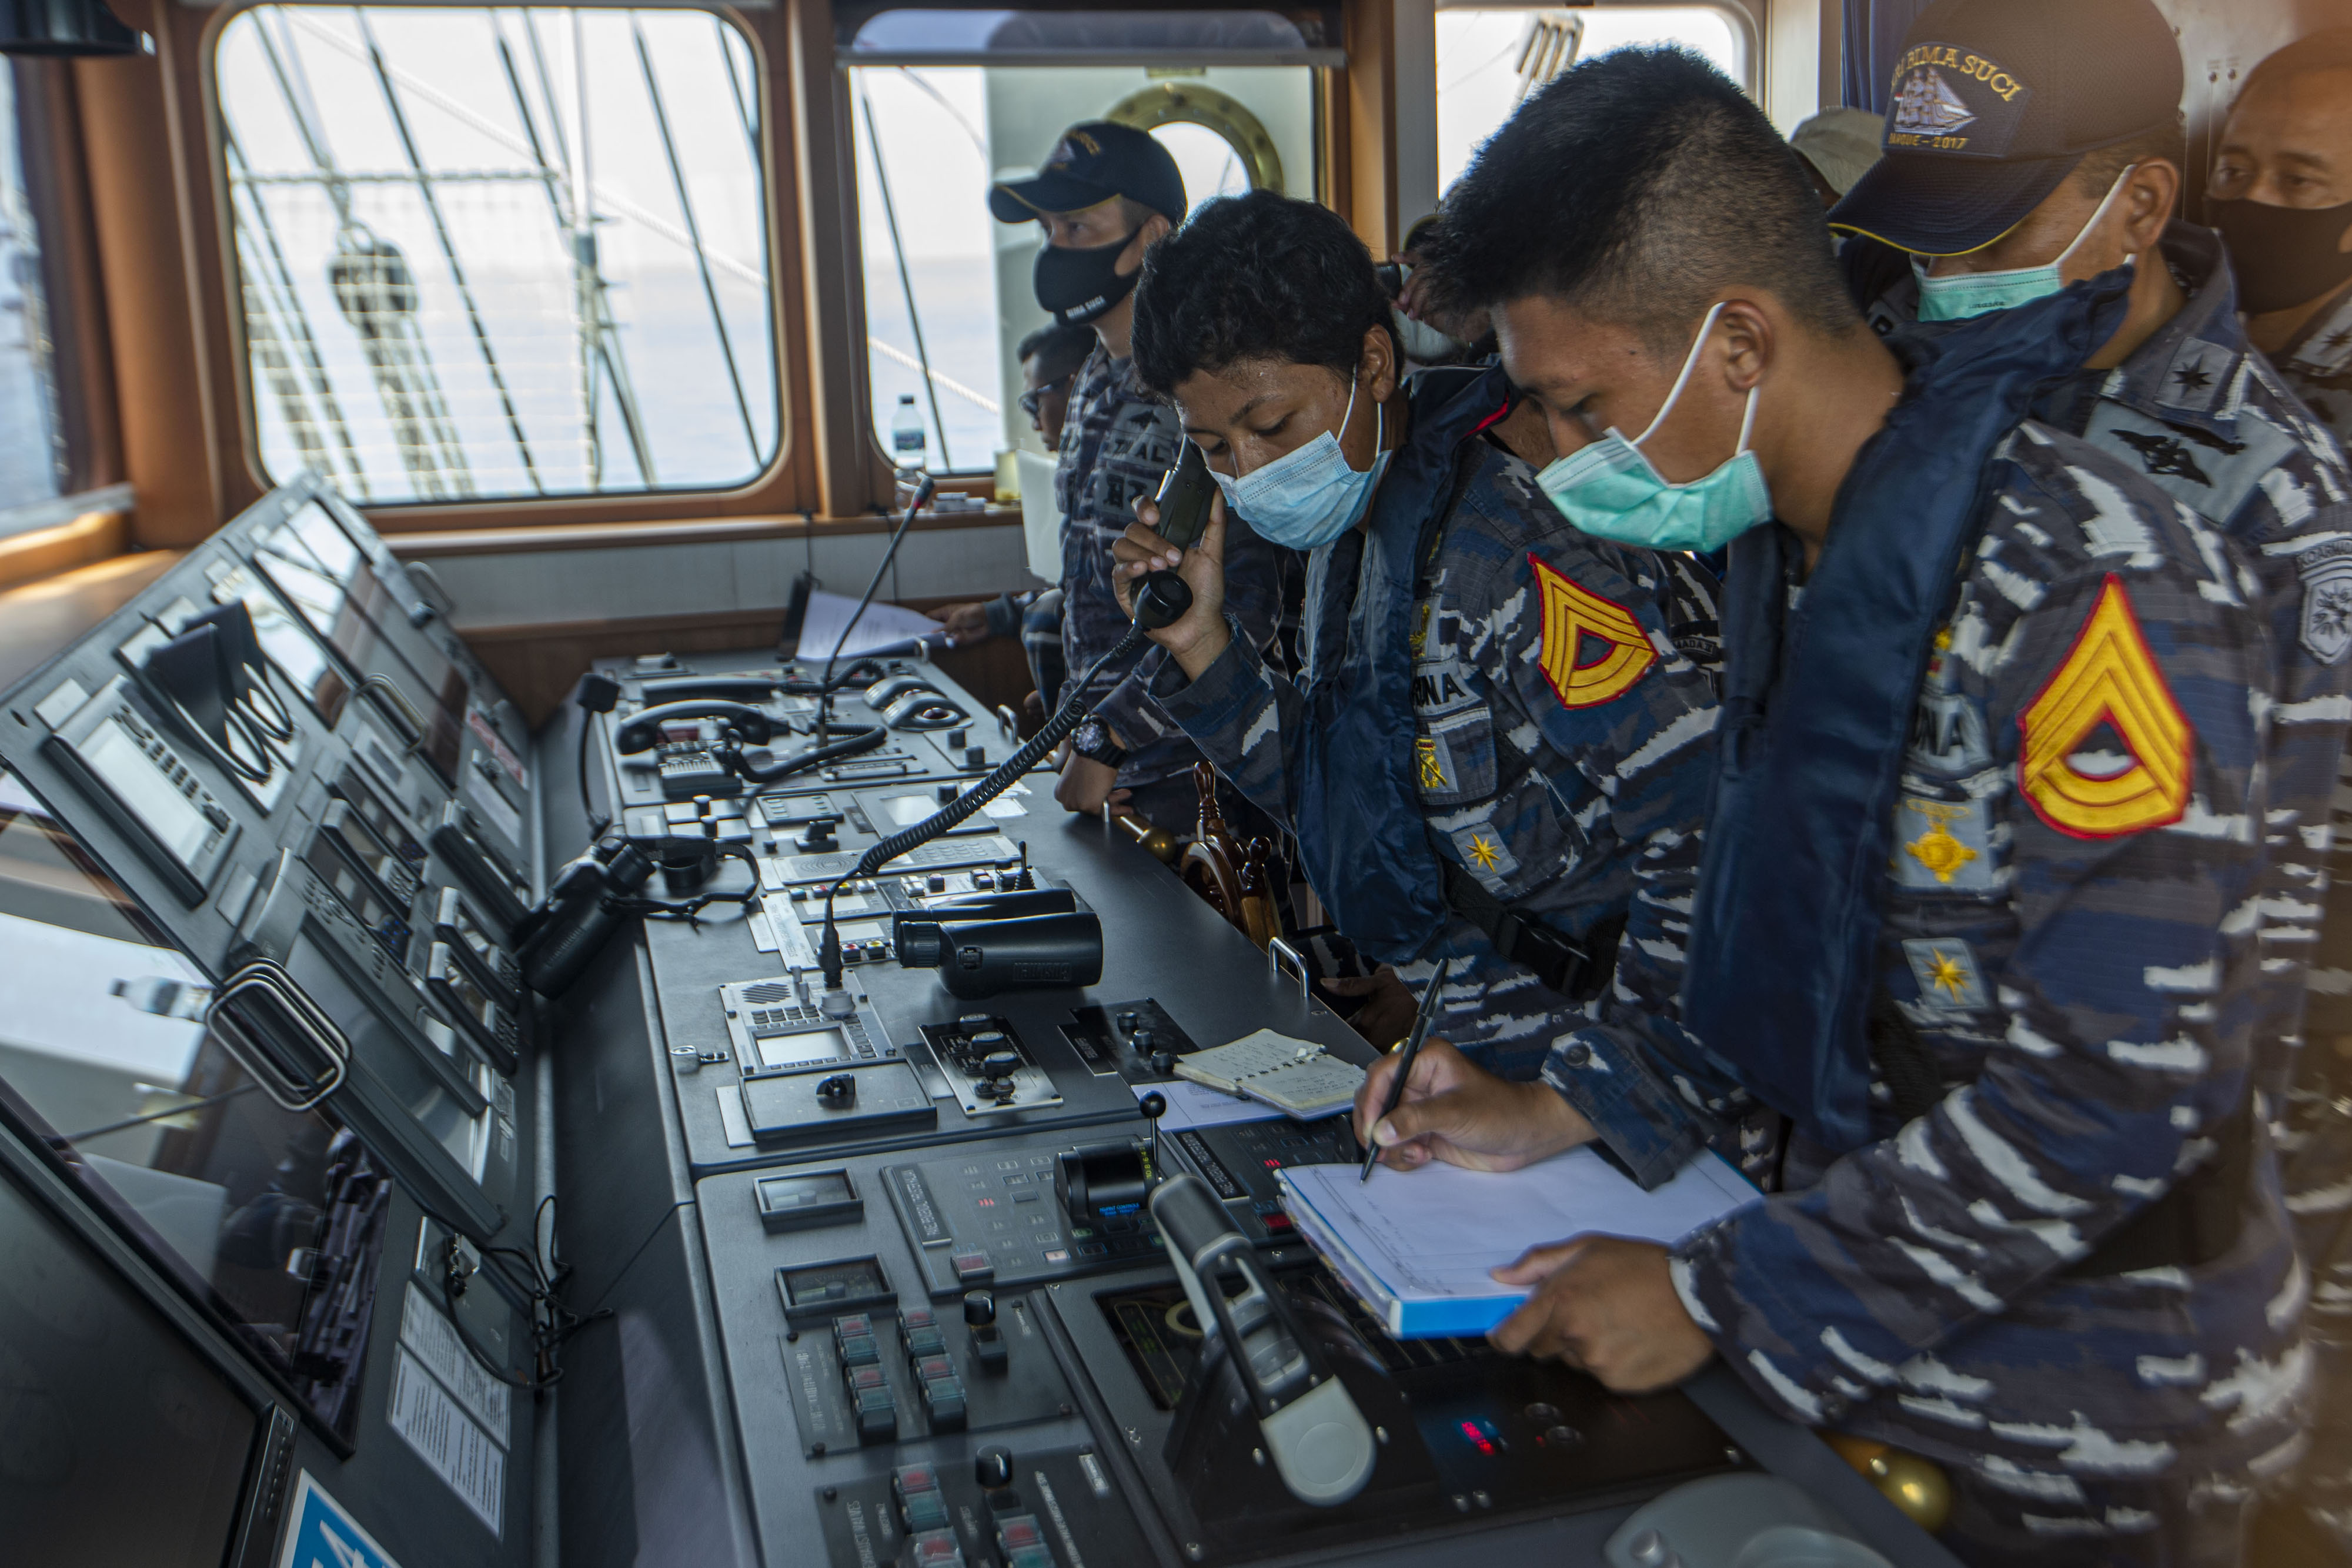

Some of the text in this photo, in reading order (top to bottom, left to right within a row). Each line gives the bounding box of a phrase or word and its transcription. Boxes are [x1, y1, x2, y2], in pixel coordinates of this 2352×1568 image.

[1906, 46, 1960, 70] BIMA
[1960, 55, 2023, 102] SUCI
[1065, 295, 1106, 320] BIMA SUCI
[1135, 442, 1165, 463] AL
